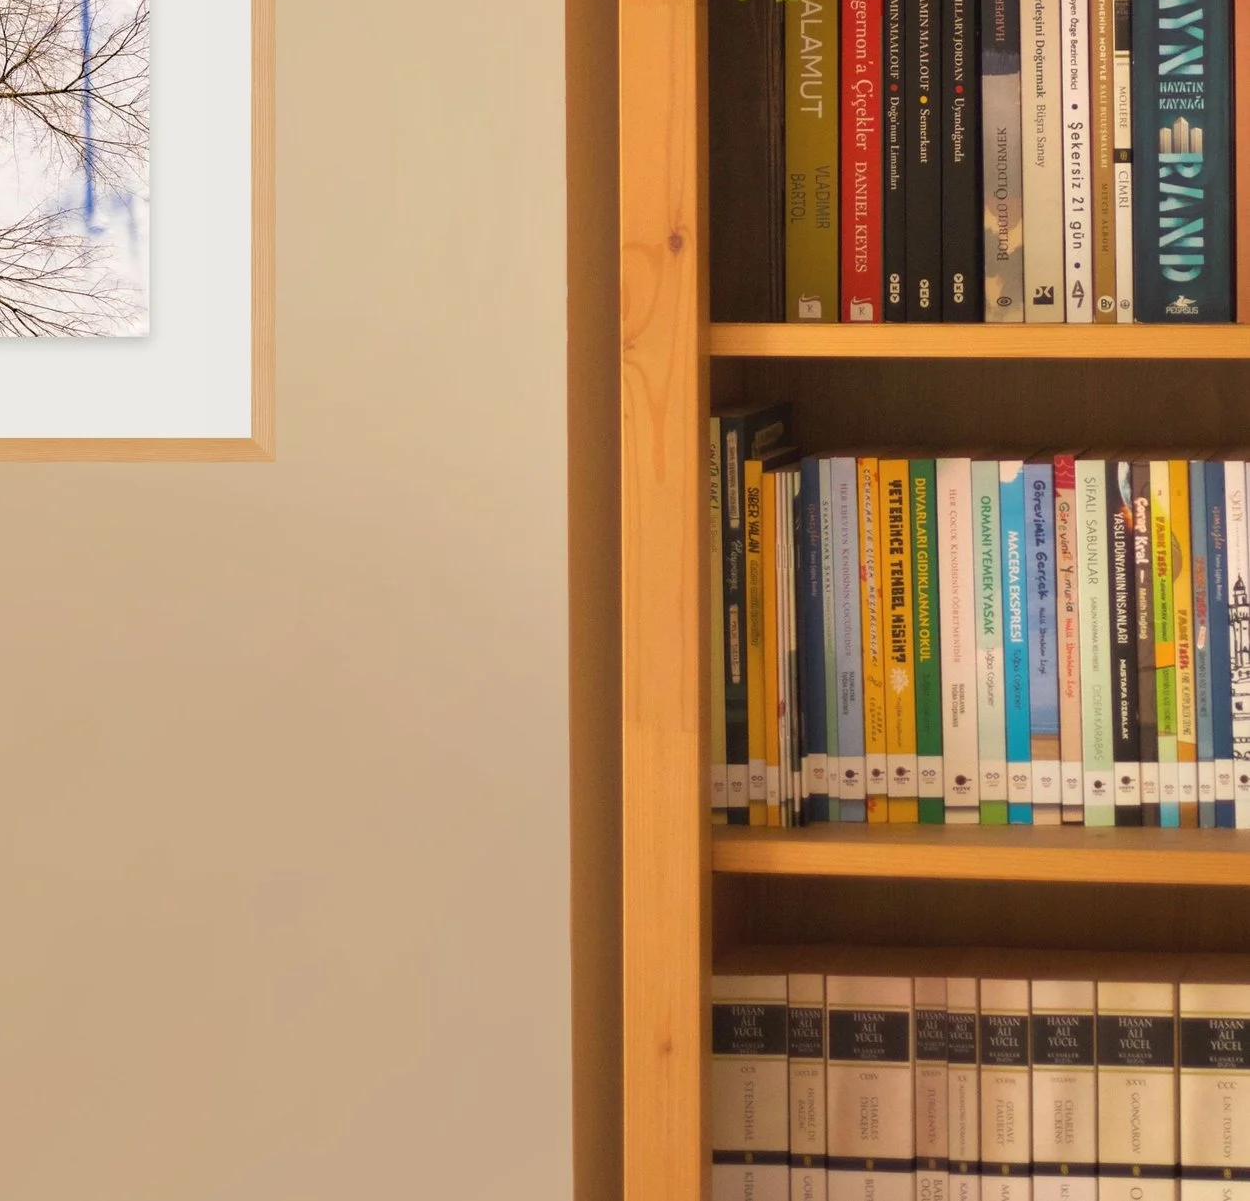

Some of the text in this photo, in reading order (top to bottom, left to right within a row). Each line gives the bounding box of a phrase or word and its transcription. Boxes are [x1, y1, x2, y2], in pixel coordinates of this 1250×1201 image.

[1068, 17, 1079, 37] Özge
[889, 22, 900, 80] MAALOUF
[918, 30, 929, 91] MAALOUF
[953, 38, 965, 81] JORDAN
[1033, 39, 1046, 98] Doğurmak
[1069, 39, 1078, 66] Bezirci
[1098, 38, 1108, 81] MORİ'YLE
[1070, 68, 1079, 91] Dikici
[1159, 81, 1204, 93] HAYATIN
[851, 78, 874, 151] Çiçekler
[887, 96, 900, 143] Doğu'nun
[1034, 104, 1047, 134] Büşra
[1159, 95, 1204, 110] KAYNAĞI
[918, 108, 930, 164] Semerkant
[951, 97, 965, 163] Uyandığında
[1035, 136, 1047, 168] Sanay
[1099, 106, 1108, 169] BULUŞMALARI
[889, 145, 901, 191] Limanları
[1067, 122, 1084, 250] Şekersiz 21 gün
[1118, 170, 1129, 209] CİMRİ
[790, 173, 806, 225] BARTOL
[854, 161, 868, 221] DANIEL
[1101, 218, 1109, 253] ALBOM
[1159, 153, 1205, 283] RAND
[854, 224, 869, 274] KEYES
[1165, 305, 1199, 314] PEGASUS
[862, 468, 872, 524] ÇOCUKLAR
[1134, 497, 1148, 531] Çorap
[748, 521, 760, 554] YALAN
[866, 529, 873, 539] VE
[1084, 477, 1099, 585] ŞİFALI SABUNLAR
[1135, 536, 1148, 564] Kral
[889, 480, 906, 663] YETERİNCE TEMBEL MİSİN?
[915, 477, 931, 663] DUVARLARI GIDIKLANAN OKUL
[980, 496, 995, 634] ORMANI YEMEK YASAK
[1008, 531, 1023, 642] MACERA EKSPRESİ
[1035, 552, 1049, 600] Gerçek
[1114, 541, 1126, 591] DÜNYANIN
[1060, 566, 1074, 612] Yumurta
[1116, 591, 1128, 644] İNSANLARI
[1121, 700, 1129, 740] ÖZBALAK
[853, 1012, 885, 1022] HASAN
[989, 1017, 1020, 1026] HASAN
[1047, 1017, 1079, 1026] HASAN
[1118, 1017, 1153, 1027] HASAN
[1209, 1020, 1244, 1029] HASAN
[989, 1036, 1020, 1046] YÜCEL
[1048, 1036, 1079, 1047] YÜCEL
[1120, 1038, 1151, 1049] YÜCEL
[1210, 1040, 1242, 1051] YÜCEL
[743, 1080, 754, 1142] STENDHAL
[859, 1096, 869, 1141] DICKENS
[869, 1097, 879, 1141] CHARLES
[996, 1099, 1005, 1146] FLAUBERT
[1006, 1101, 1015, 1143] GUSTAVE
[1054, 1100, 1064, 1144] DICKENS
[1064, 1100, 1074, 1144] CHARLES
[1222, 1117, 1232, 1159] TOLSTOY
